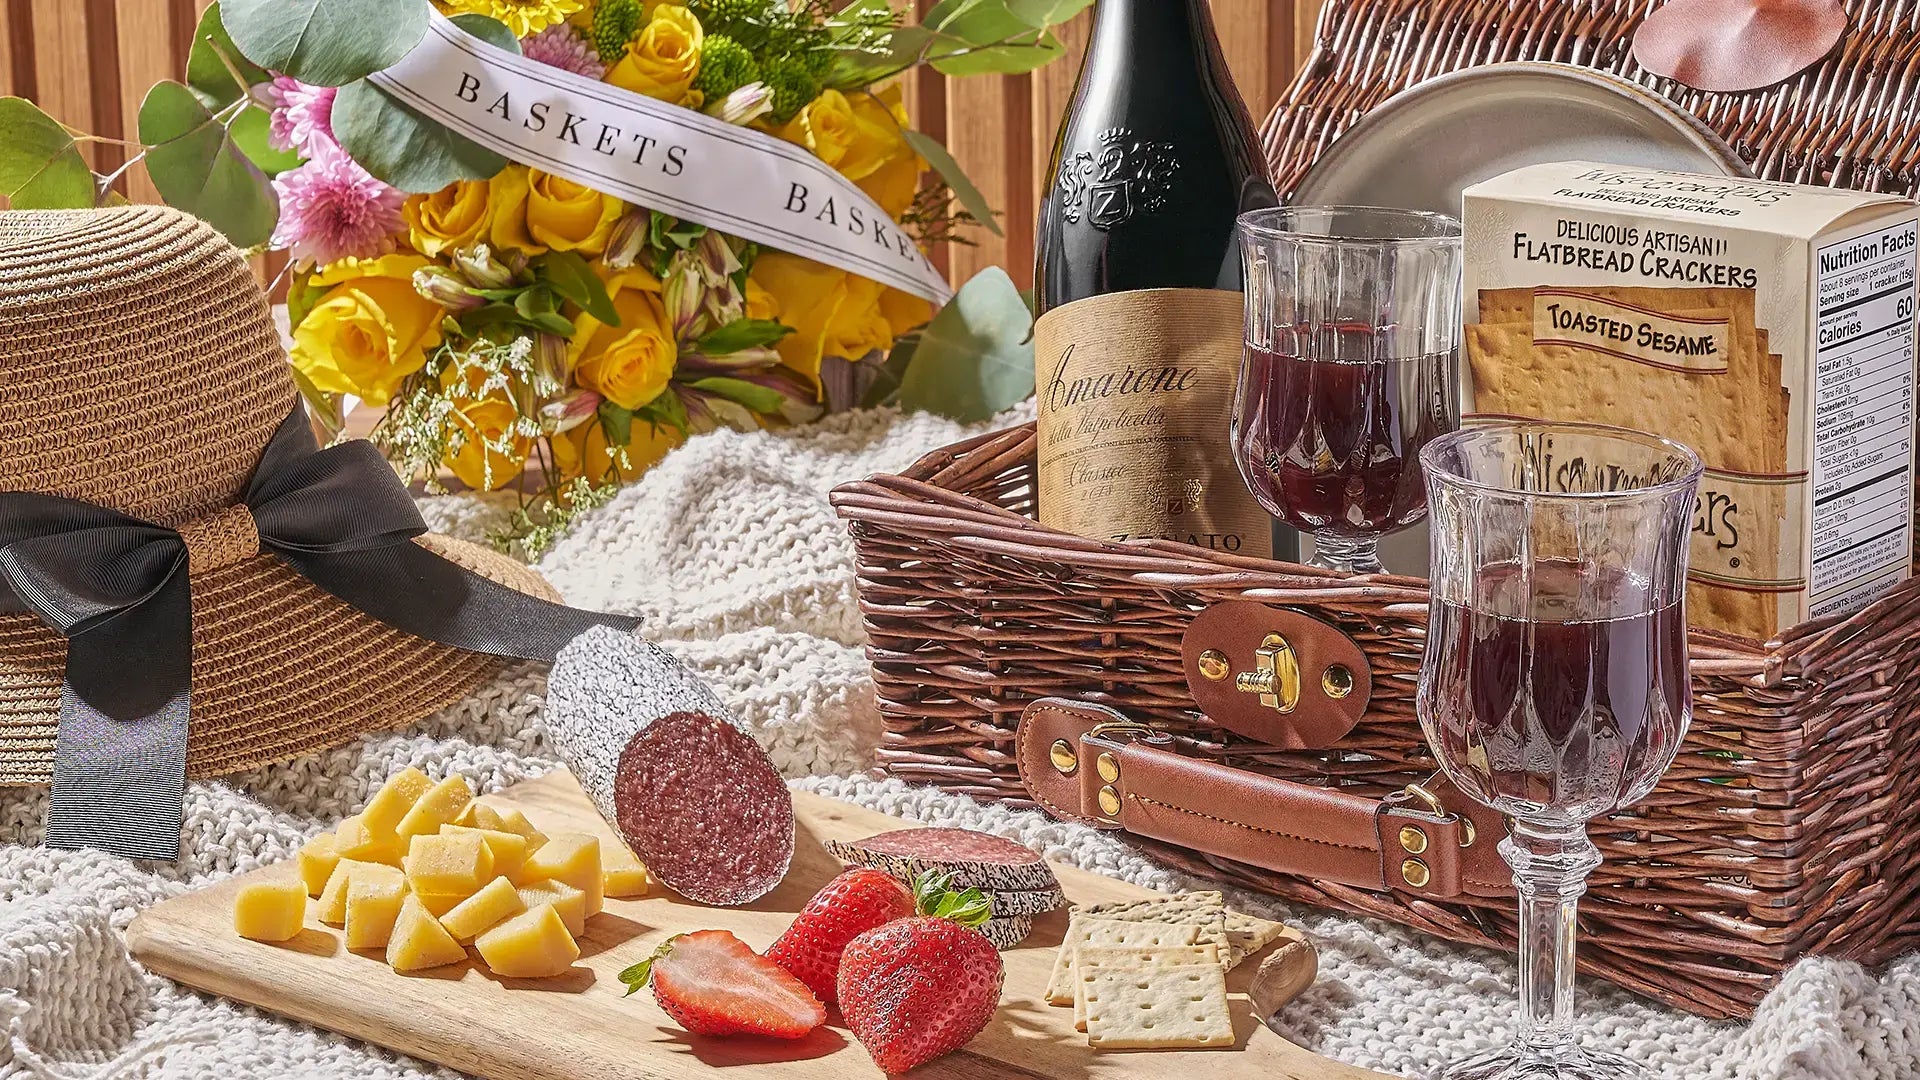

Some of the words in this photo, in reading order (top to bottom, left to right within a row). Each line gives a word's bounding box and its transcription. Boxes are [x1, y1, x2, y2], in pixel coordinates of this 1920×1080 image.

[454, 71, 689, 177] BASKETS
[1553, 188, 1650, 206] FLATBREAD
[1650, 200, 1742, 216] CRACKERS
[1595, 188, 1662, 200] DELICIOUS
[1660, 196, 1719, 207] ARTISAN
[1557, 219, 1639, 247] DELICIOUS
[1513, 232, 1635, 274] FLATBREAD
[1639, 249, 1758, 289] CRACKERS
[1821, 243, 1877, 274] Nutrition
[1882, 230, 1915, 255] Facts
[1820, 281, 1838, 293] About
[1845, 272, 1868, 286] servings
[1870, 268, 1879, 279] per
[1880, 259, 1906, 274] container
[1820, 293, 1844, 306] Serving
[1846, 288, 1859, 298] size
[1875, 275, 1898, 288] cracker
[1899, 267, 1914, 282] (15g)
[1546, 303, 1633, 342] TOASTED
[1636, 323, 1718, 356] SESAME
[1819, 317, 1835, 327] Amount
[1843, 311, 1857, 319] serving
[1819, 321, 1861, 344] Calories
[1897, 296, 1912, 318] 60
[1818, 363, 1831, 374] Total
[1832, 360, 1841, 369] Fat
[1040, 343, 1200, 414] Amarone
[1822, 372, 1845, 386] Saturated
[1817, 398, 1847, 415] Cholesterol
[1817, 417, 1836, 429] Sodium
[1817, 431, 1829, 442] Total
[1831, 420, 1865, 437] Carbohydrate
[1820, 444, 1837, 455] Dietary
[1820, 458, 1831, 468] Total
[1832, 453, 1848, 464] Sugars
[1824, 468, 1843, 480] Includes
[1852, 457, 1866, 469] Added
[1867, 453, 1883, 464] Sugars
[1815, 485, 1834, 497] Protein
[1814, 518, 1833, 531] Calcium
[1110, 533, 1242, 551] ZATO
[1813, 543, 1838, 558] Potassium
[1811, 598, 1849, 618] INGREDIENTS:
[1851, 588, 1871, 603] Enriched
[1872, 577, 1898, 594] Unbleached
